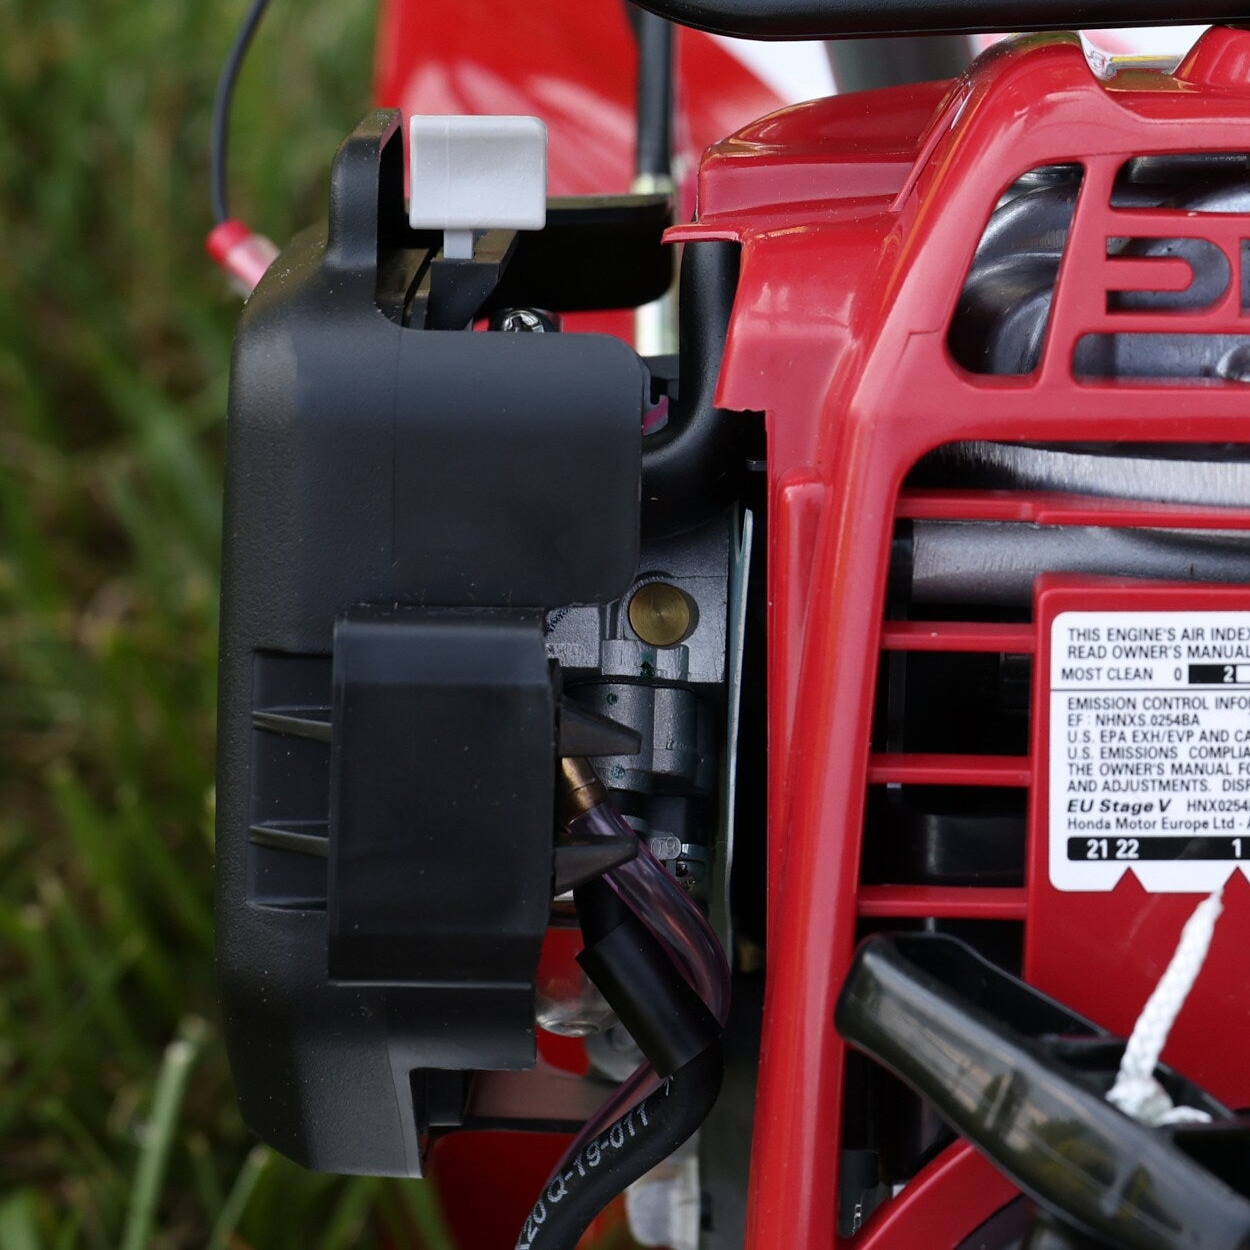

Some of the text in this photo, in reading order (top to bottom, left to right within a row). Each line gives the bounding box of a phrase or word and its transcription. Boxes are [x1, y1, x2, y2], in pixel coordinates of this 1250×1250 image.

[1068, 628, 1101, 641] THIS
[1107, 627, 1176, 641] ENGINE'S
[1181, 627, 1205, 641] AIR
[1068, 645, 1107, 659] READ
[1112, 645, 1182, 659] OWNER'S
[1061, 668, 1102, 681] MOST
[1107, 667, 1153, 681] CLEAN
[1174, 668, 1182, 681] 0
[1223, 666, 1235, 683] 2
[1068, 697, 1137, 711] EMISSION
[1142, 697, 1209, 711] CONTROL
[1068, 713, 1082, 726] EF
[1096, 713, 1200, 726] NHNXS.0254BA
[1068, 730, 1096, 743] U.S.
[1100, 730, 1126, 743] EPA
[1132, 729, 1194, 743] EXH/EVP
[1199, 729, 1229, 742] AND
[1068, 747, 1094, 760] U.S.
[1100, 746, 1178, 760] EMISSIONS
[1068, 762, 1093, 776] THE
[1100, 762, 1165, 776] OWNER'S
[1170, 762, 1232, 776] MANUAL
[1068, 780, 1098, 792] AND
[1102, 780, 1211, 792] ADJUSTMENTS.
[1067, 800, 1094, 813] EU
[1099, 800, 1153, 816] Stage
[1159, 799, 1172, 812] V
[1067, 817, 1111, 830] Honda
[1115, 817, 1156, 830] Motor
[1161, 816, 1209, 832] Europe
[1214, 816, 1234, 830] Ltd
[1086, 838, 1108, 860] 21
[1115, 838, 1139, 860] 22
[1232, 838, 1242, 859] 1
